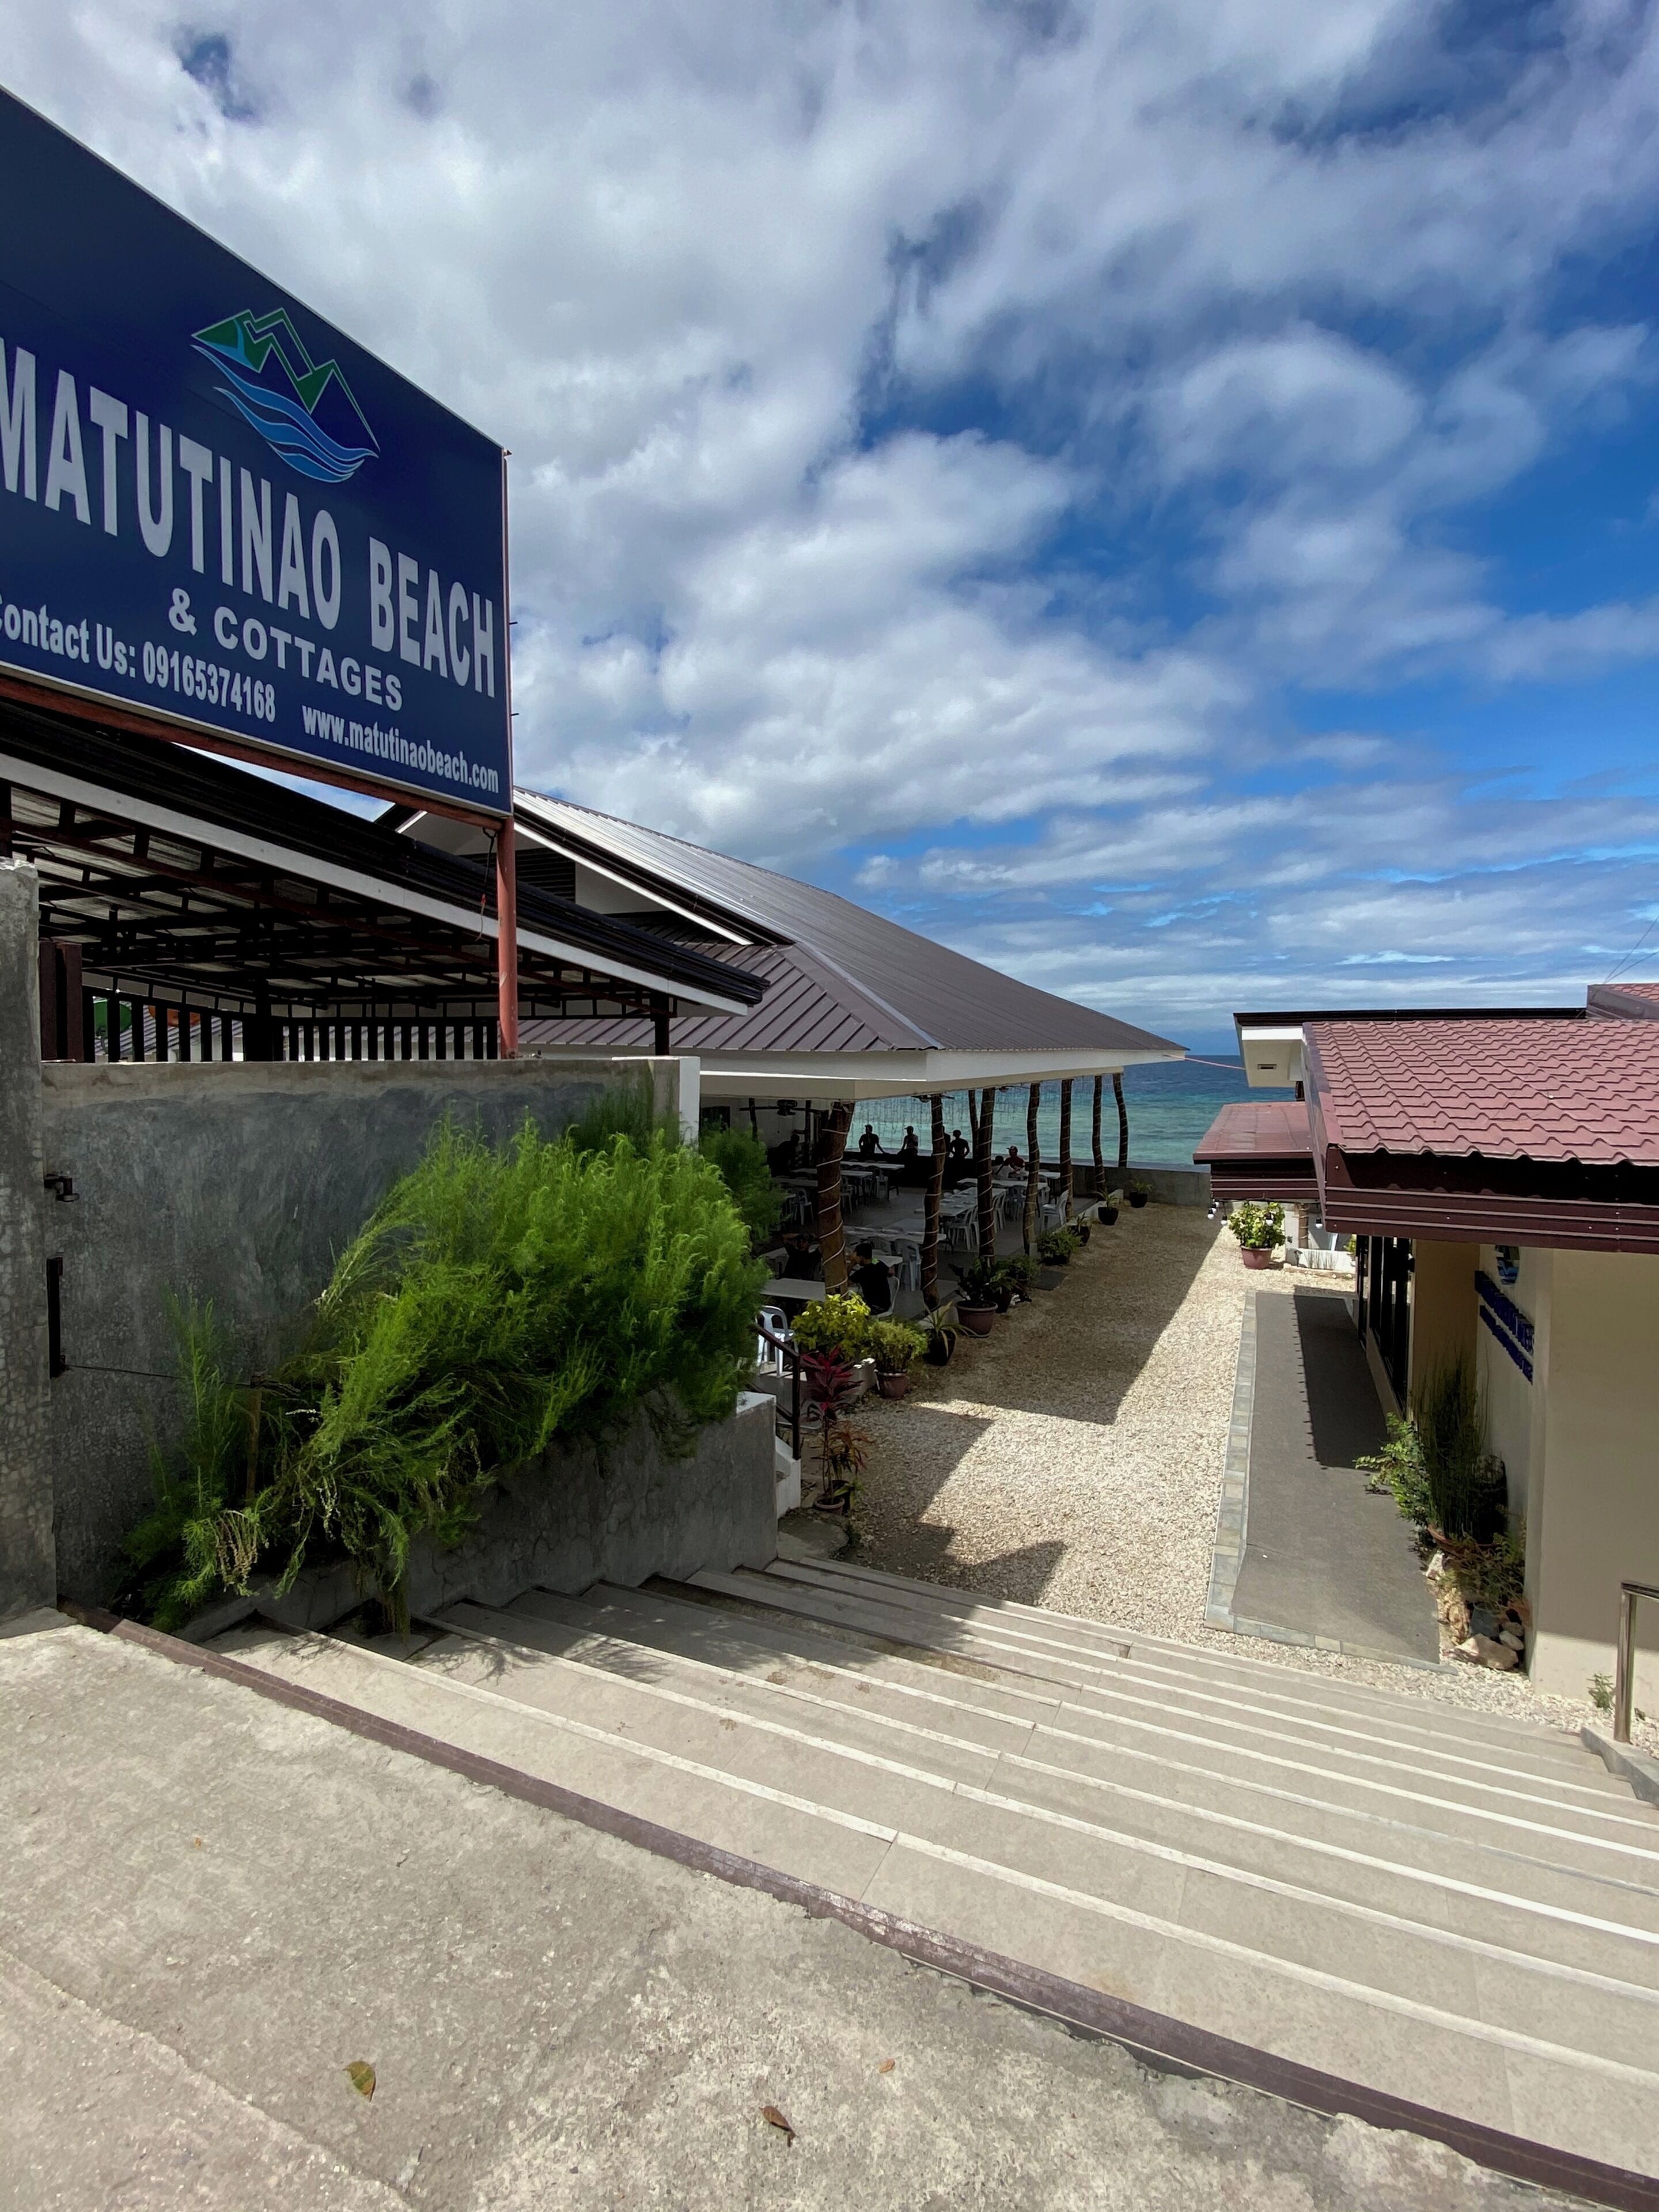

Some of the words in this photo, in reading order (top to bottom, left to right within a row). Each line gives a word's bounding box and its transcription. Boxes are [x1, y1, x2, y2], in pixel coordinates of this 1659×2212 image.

[0, 336, 341, 630] MATUTINAO
[369, 537, 494, 698] BEACH
[0, 592, 89, 663] ontact
[96, 623, 135, 677] Us:
[143, 641, 275, 722] 09165374168
[169, 588, 197, 635] &
[214, 607, 402, 711] COTTAGES
[302, 706, 498, 793] www.matutinaobeach.com
